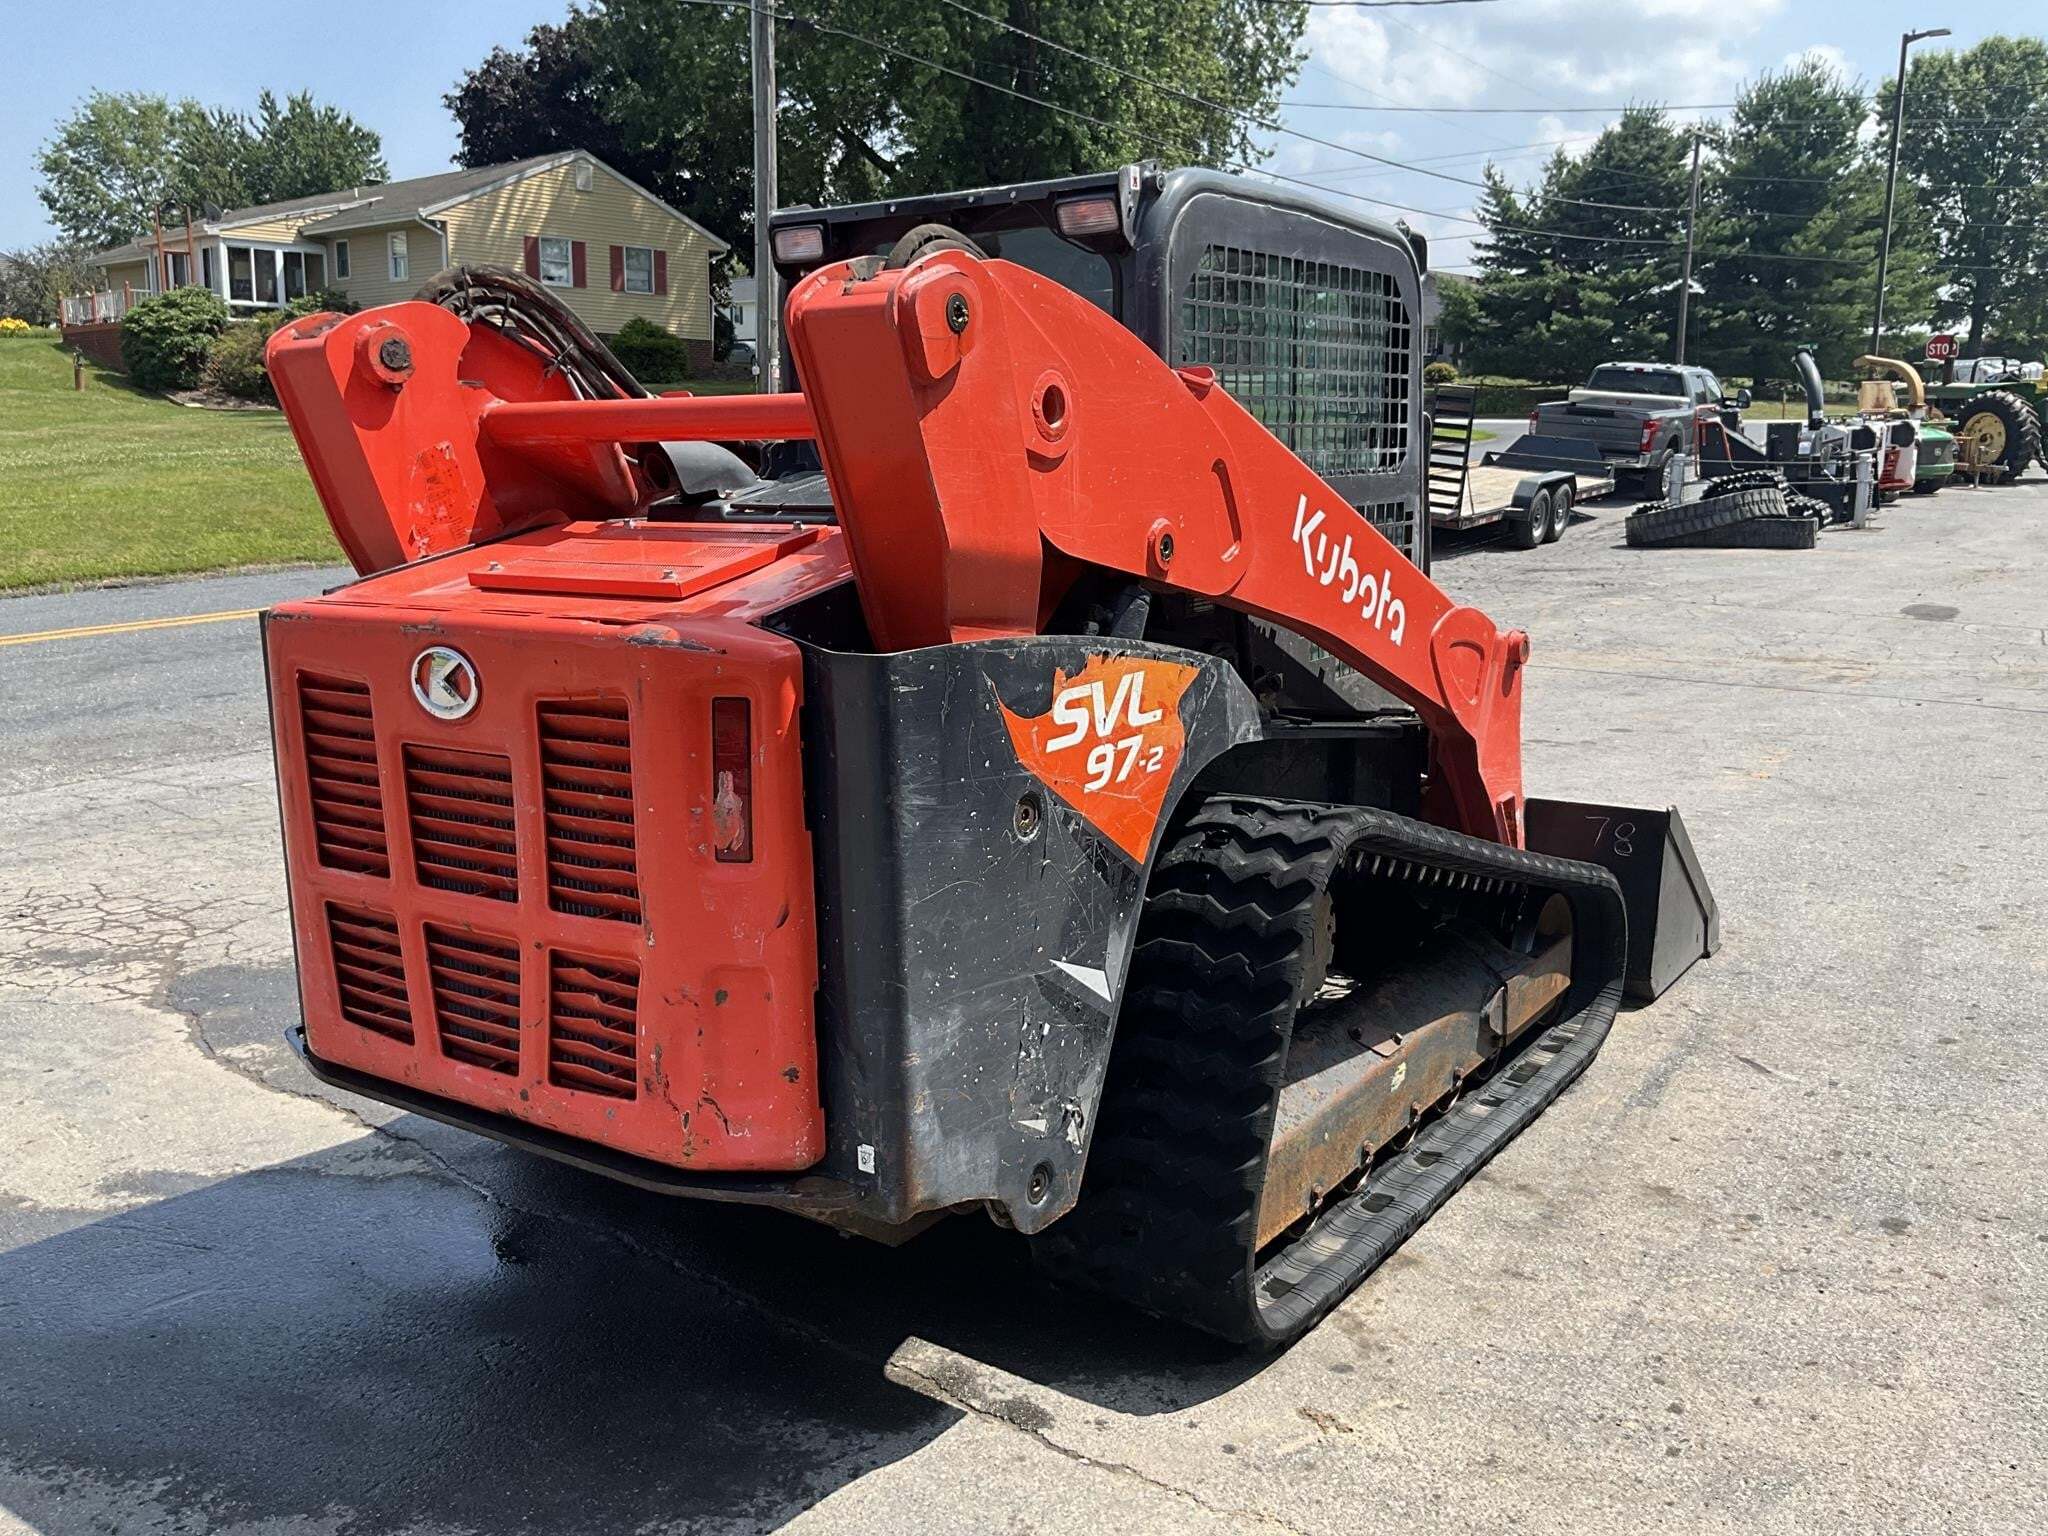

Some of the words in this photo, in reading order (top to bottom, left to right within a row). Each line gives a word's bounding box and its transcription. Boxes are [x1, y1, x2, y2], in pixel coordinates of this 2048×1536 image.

[1292, 493, 1406, 647] Kubota
[1045, 670, 1163, 753] SVL
[1083, 733, 1164, 794] 97-2
[1584, 815, 1636, 857] 78
